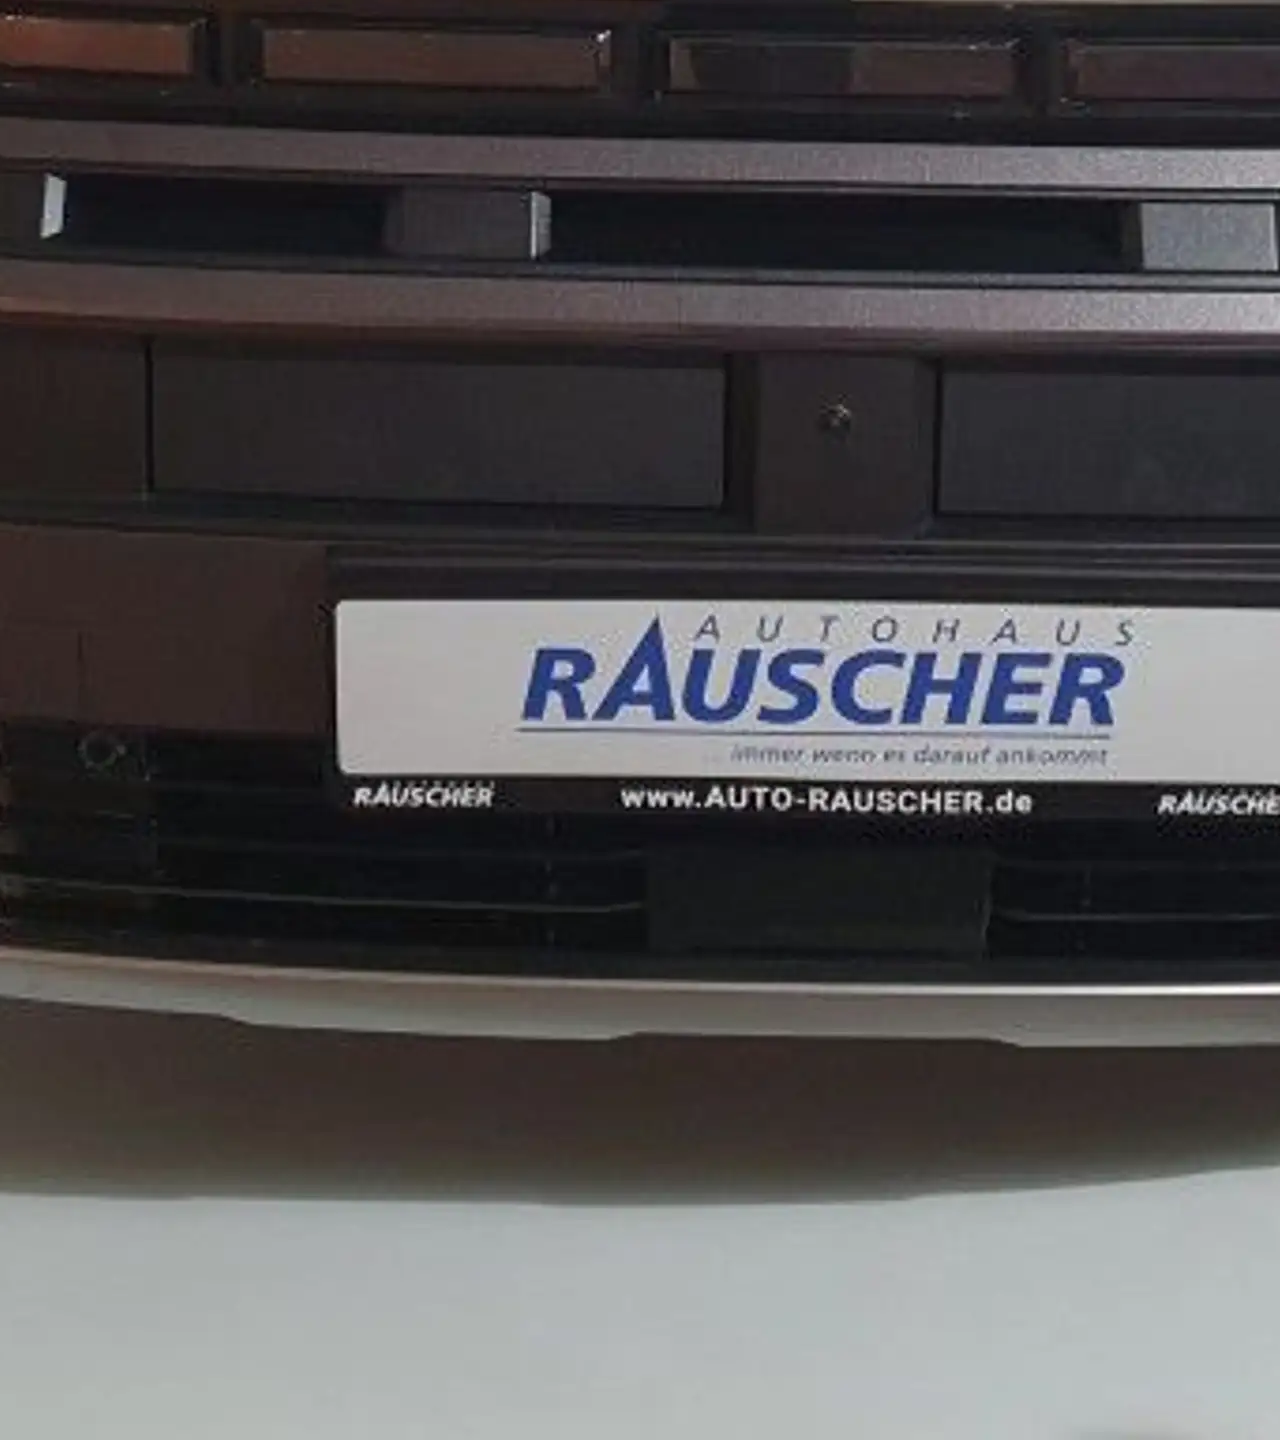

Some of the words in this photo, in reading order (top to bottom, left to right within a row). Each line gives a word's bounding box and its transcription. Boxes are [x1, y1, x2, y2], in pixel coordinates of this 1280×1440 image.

[694, 613, 1135, 647] AUTOHAUS
[523, 613, 1126, 725] RAUSCHER
[913, 744, 991, 765] darauf
[354, 781, 494, 808] RAUSCHER
[620, 785, 1033, 815] www.AUTO-RAUSCHER.de
